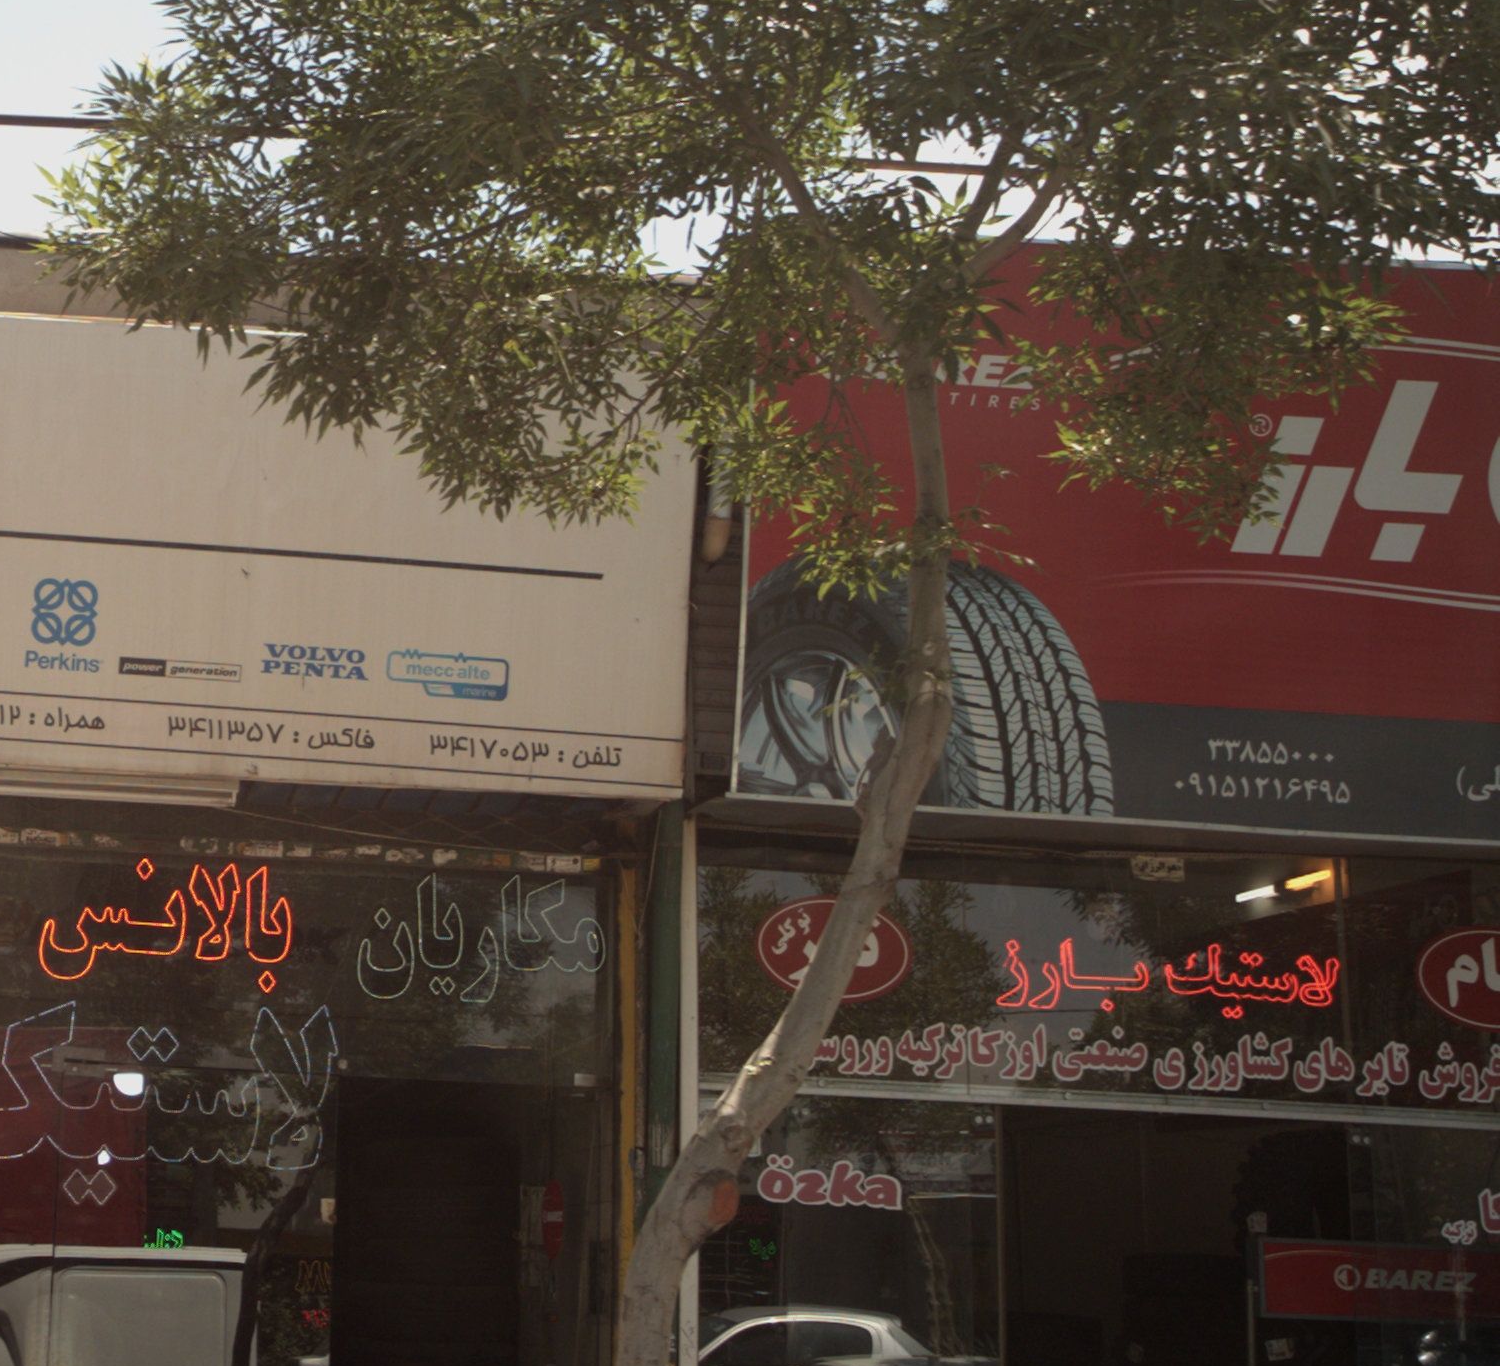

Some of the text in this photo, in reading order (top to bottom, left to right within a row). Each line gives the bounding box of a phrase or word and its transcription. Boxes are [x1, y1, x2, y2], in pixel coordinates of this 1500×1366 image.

[949, 391, 1042, 412] TIRES
[23, 650, 102, 673] Perkins
[263, 642, 367, 665] VOLVO
[120, 660, 240, 680] power generation
[260, 659, 370, 682] PENTA
[167, 715, 286, 743] ۳۴۱۱۳۵۷
[307, 726, 376, 751] فاکس
[428, 733, 551, 763] ۳۴۱۷۰۵۳
[571, 745, 623, 769] تلفن
[1207, 738, 1334, 765] ۳۳۸۵۵۰۰۰
[1175, 771, 1351, 805] ۰۹۱۵۱۲۱۶۴۹۵
[38, 856, 294, 994] بالانس
[356, 872, 607, 1003] مکاریان
[995, 937, 1151, 1013] بارز
[1051, 1024, 1149, 1083] صنعتی
[757, 1153, 903, 1212] özka
[1363, 1267, 1478, 1293] BAREZ
